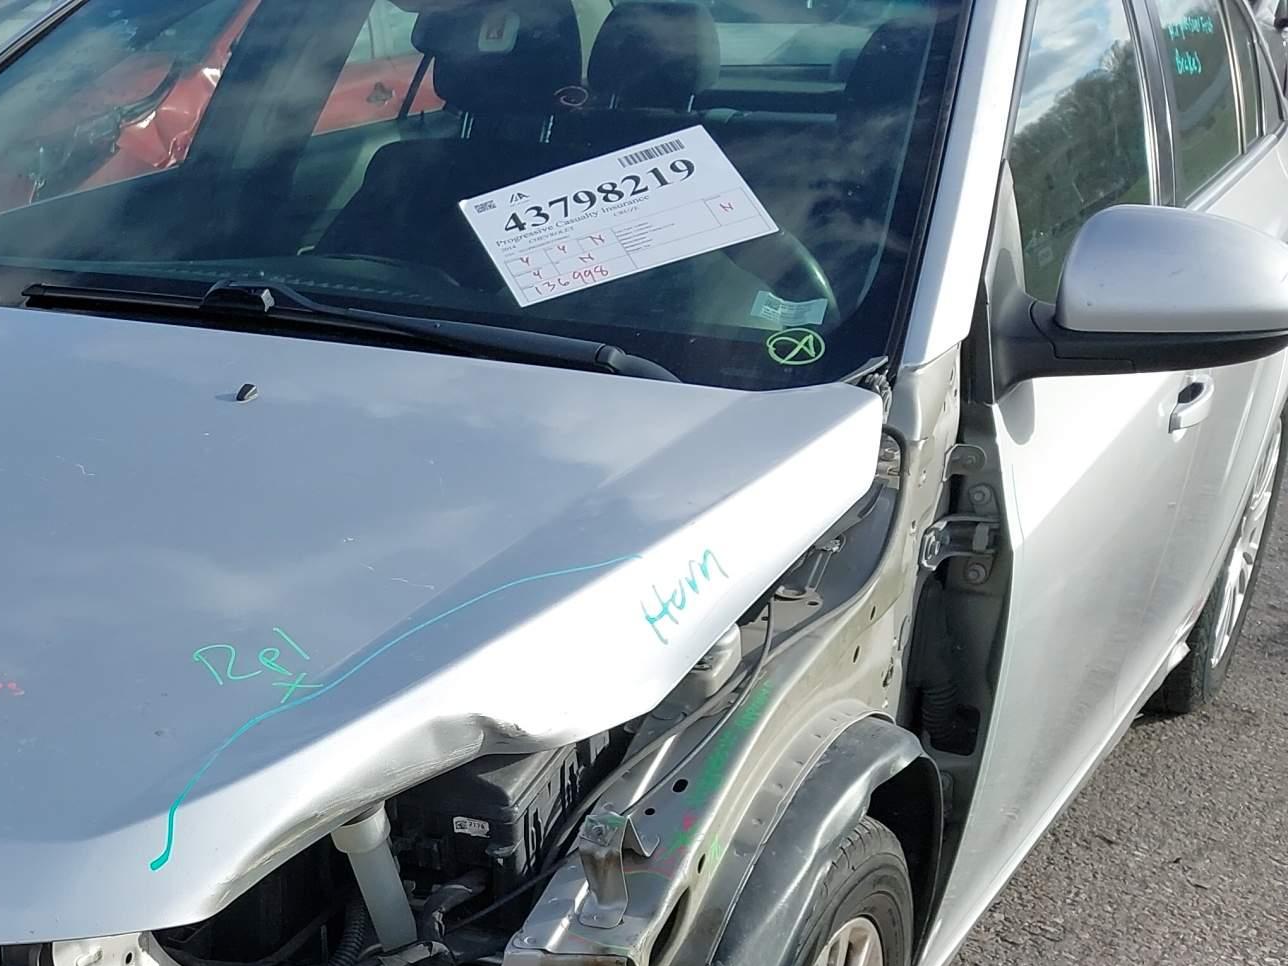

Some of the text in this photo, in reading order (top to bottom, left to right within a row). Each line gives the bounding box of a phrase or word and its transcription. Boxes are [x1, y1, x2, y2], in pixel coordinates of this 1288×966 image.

[495, 225, 553, 248] Progressive
[555, 210, 599, 228] Casualty
[600, 195, 650, 214] Insurance
[504, 158, 695, 232] 43798219
